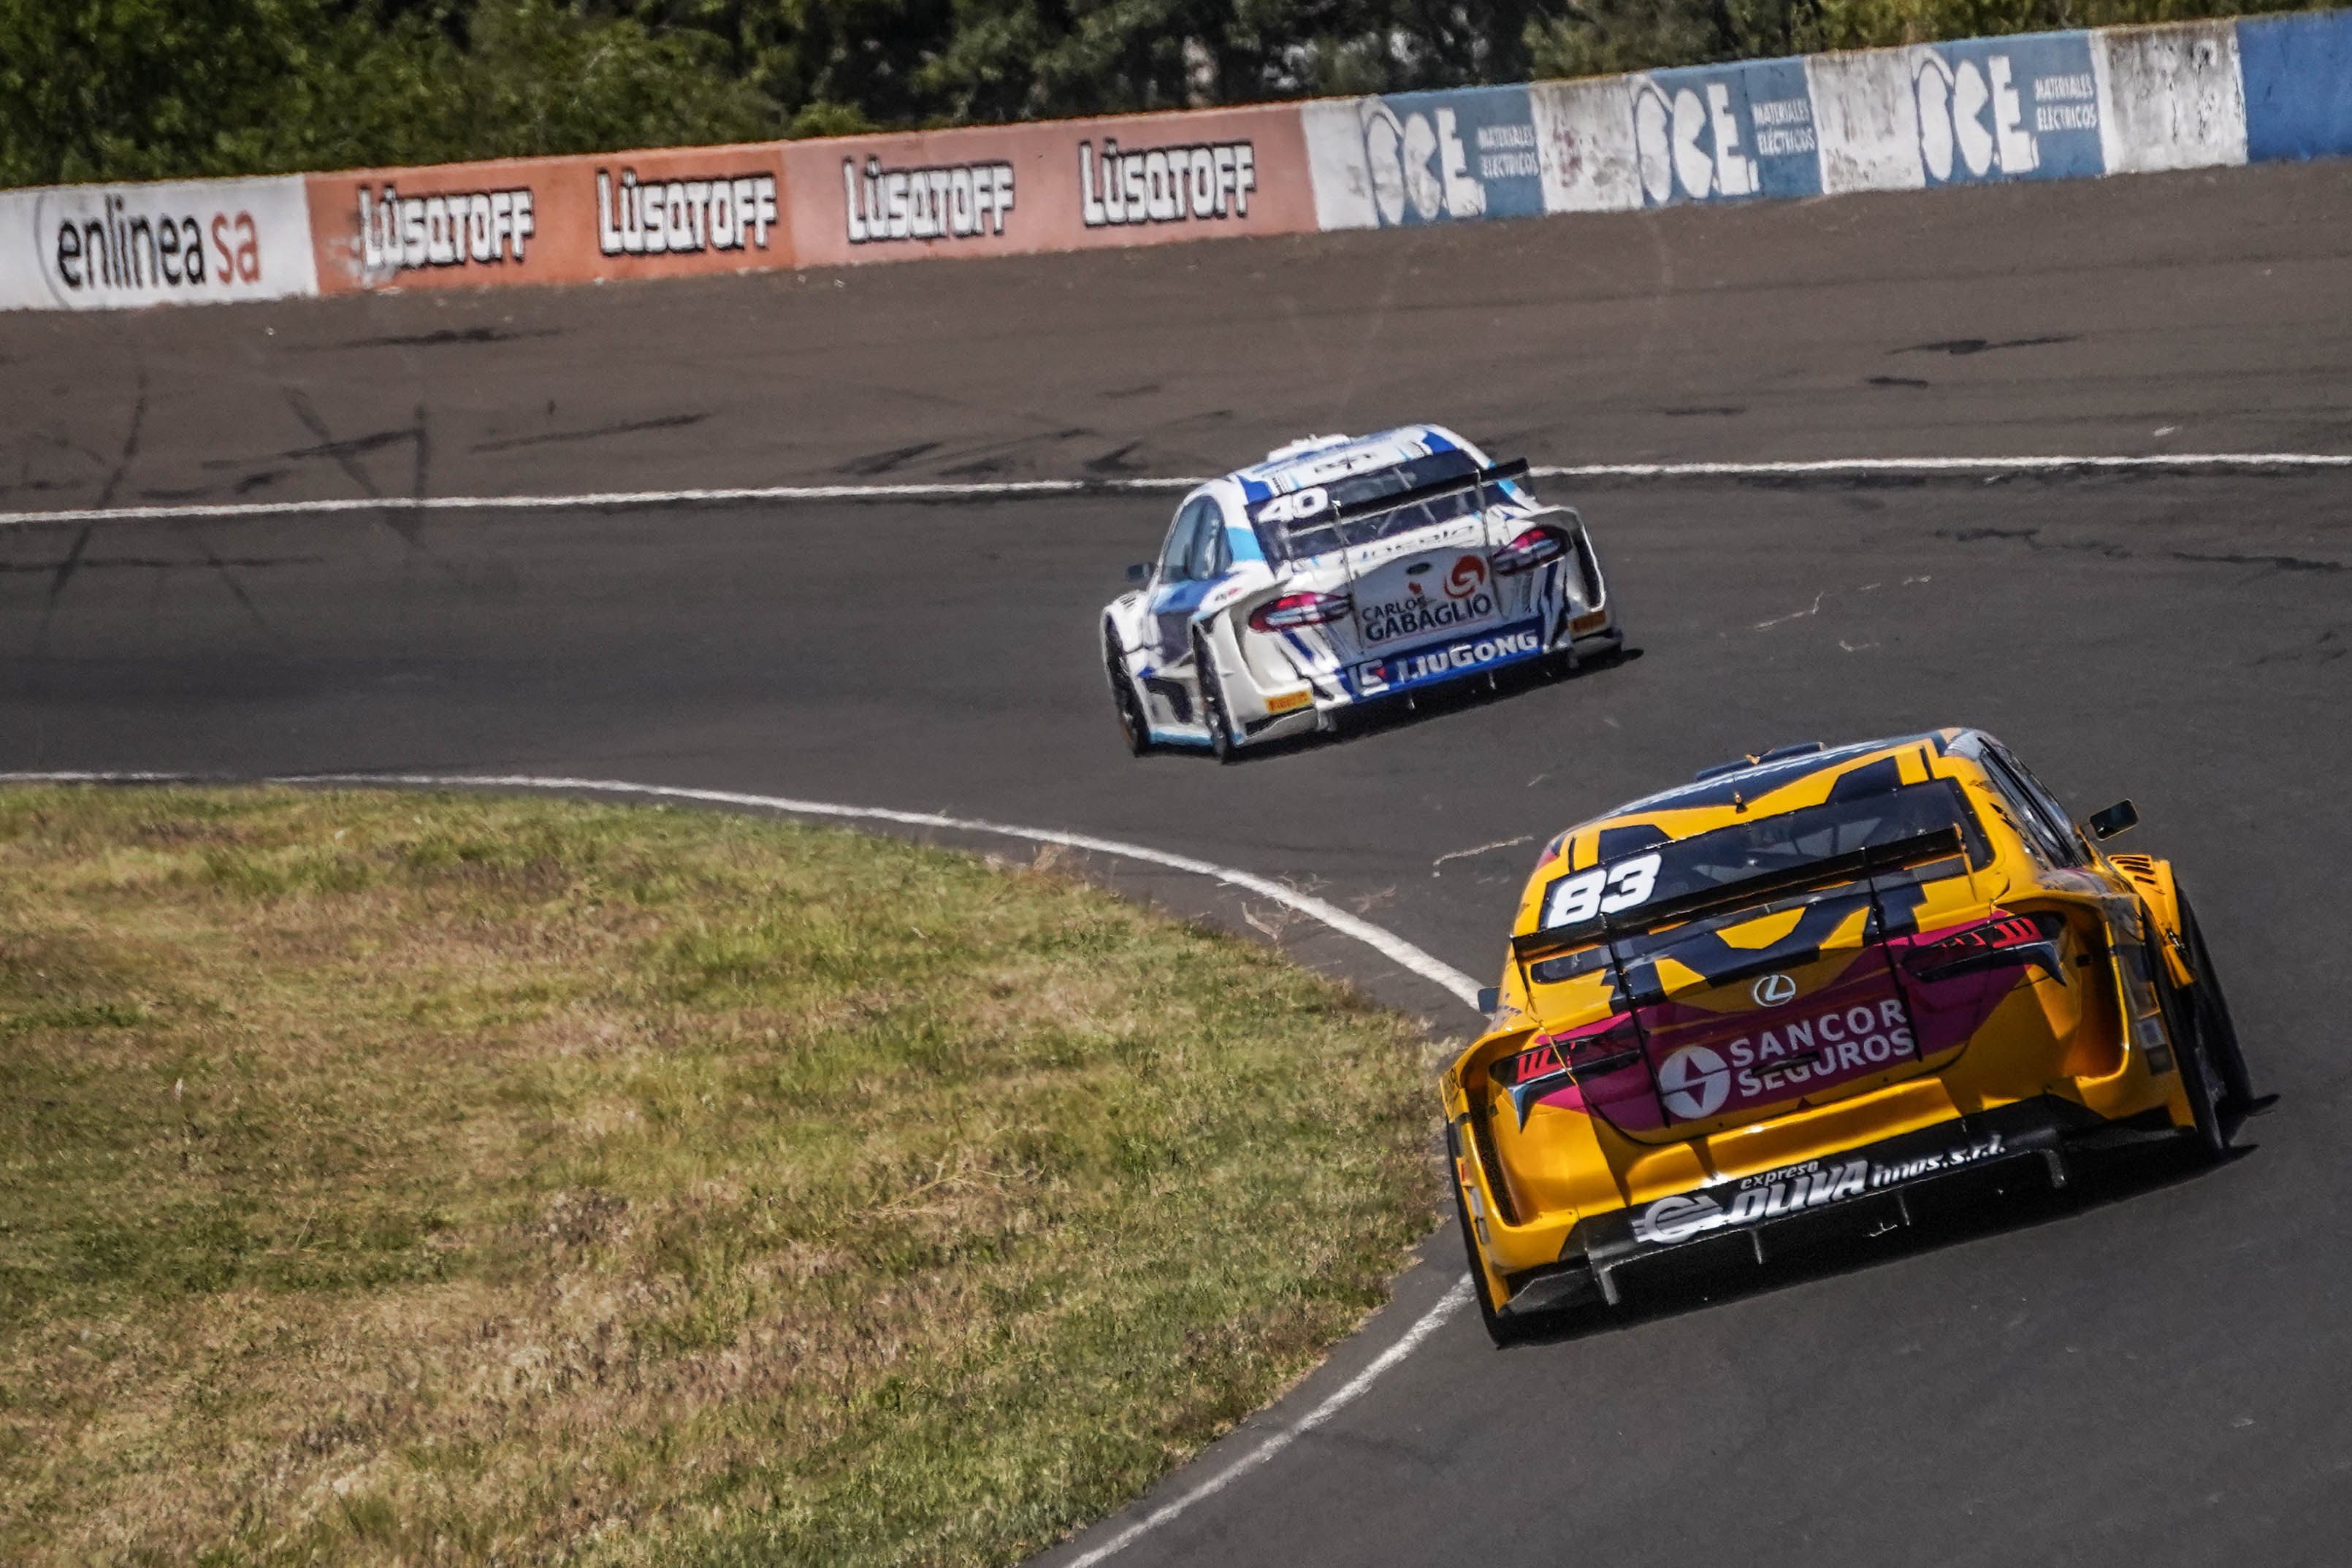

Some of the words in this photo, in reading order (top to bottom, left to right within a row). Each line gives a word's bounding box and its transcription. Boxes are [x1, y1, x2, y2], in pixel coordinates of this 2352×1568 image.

[1256, 486, 1328, 523] 40
[1365, 593, 1492, 641] GABAGLIO
[1546, 853, 1662, 929] 83
[1730, 999, 1907, 1068] SANCOR
[1738, 1028, 1916, 1097] SEGUROS
[1727, 1160, 1868, 1225] OLIVA
[1741, 1160, 1819, 1190] expreso
